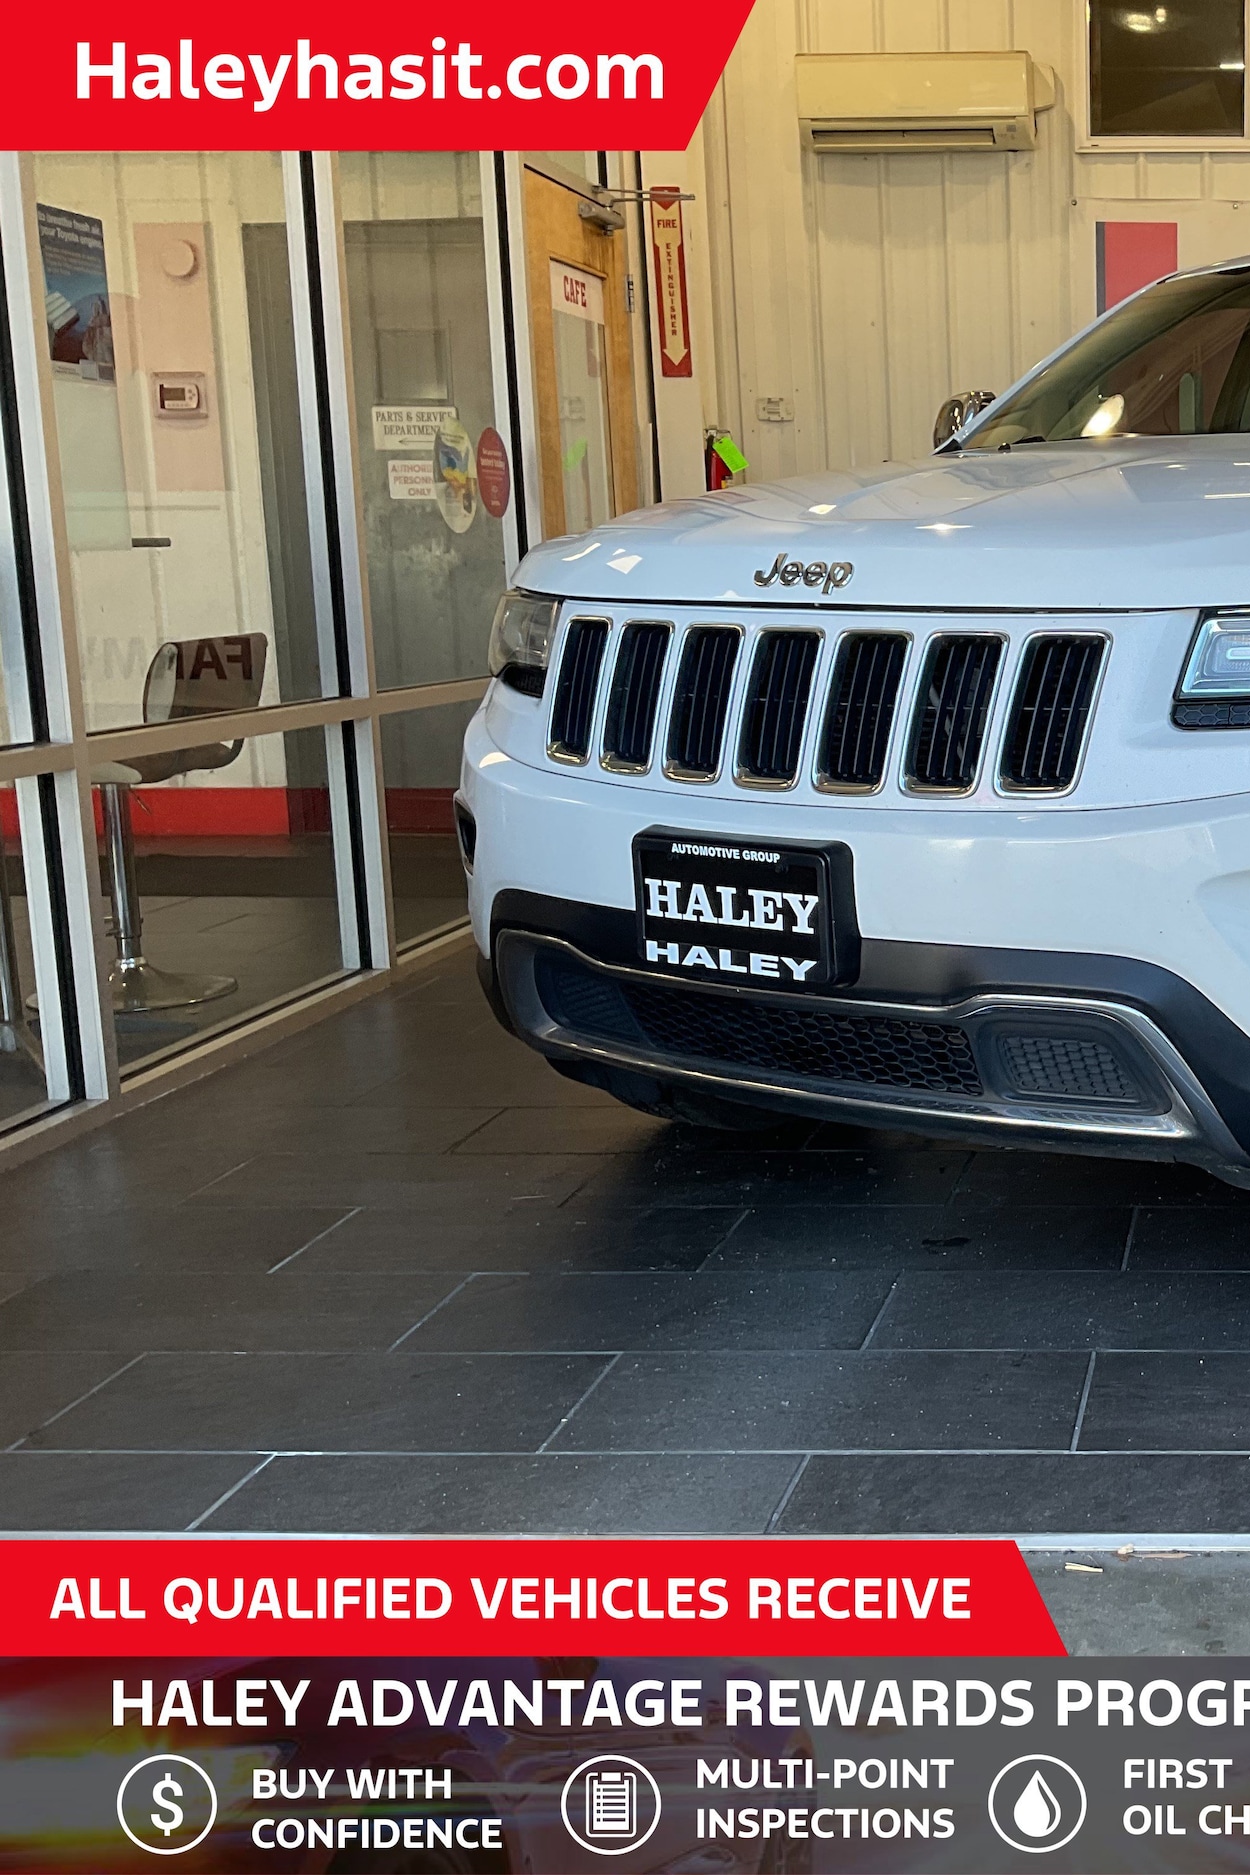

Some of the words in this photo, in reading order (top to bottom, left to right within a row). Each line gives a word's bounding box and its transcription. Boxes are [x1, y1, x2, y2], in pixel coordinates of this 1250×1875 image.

[657, 219, 677, 228] FIRE
[563, 275, 587, 308] CAFE
[665, 243, 677, 336] EXTINGUISHER
[376, 411, 403, 422] PARTS
[406, 411, 413, 421] &
[408, 488, 431, 496] ONLY
[754, 552, 855, 595] Jeep
[671, 843, 740, 859] AUTOMOTIVE
[742, 850, 781, 863] GROUP
[645, 878, 819, 935] HALEY
[646, 940, 817, 981] HALEY
